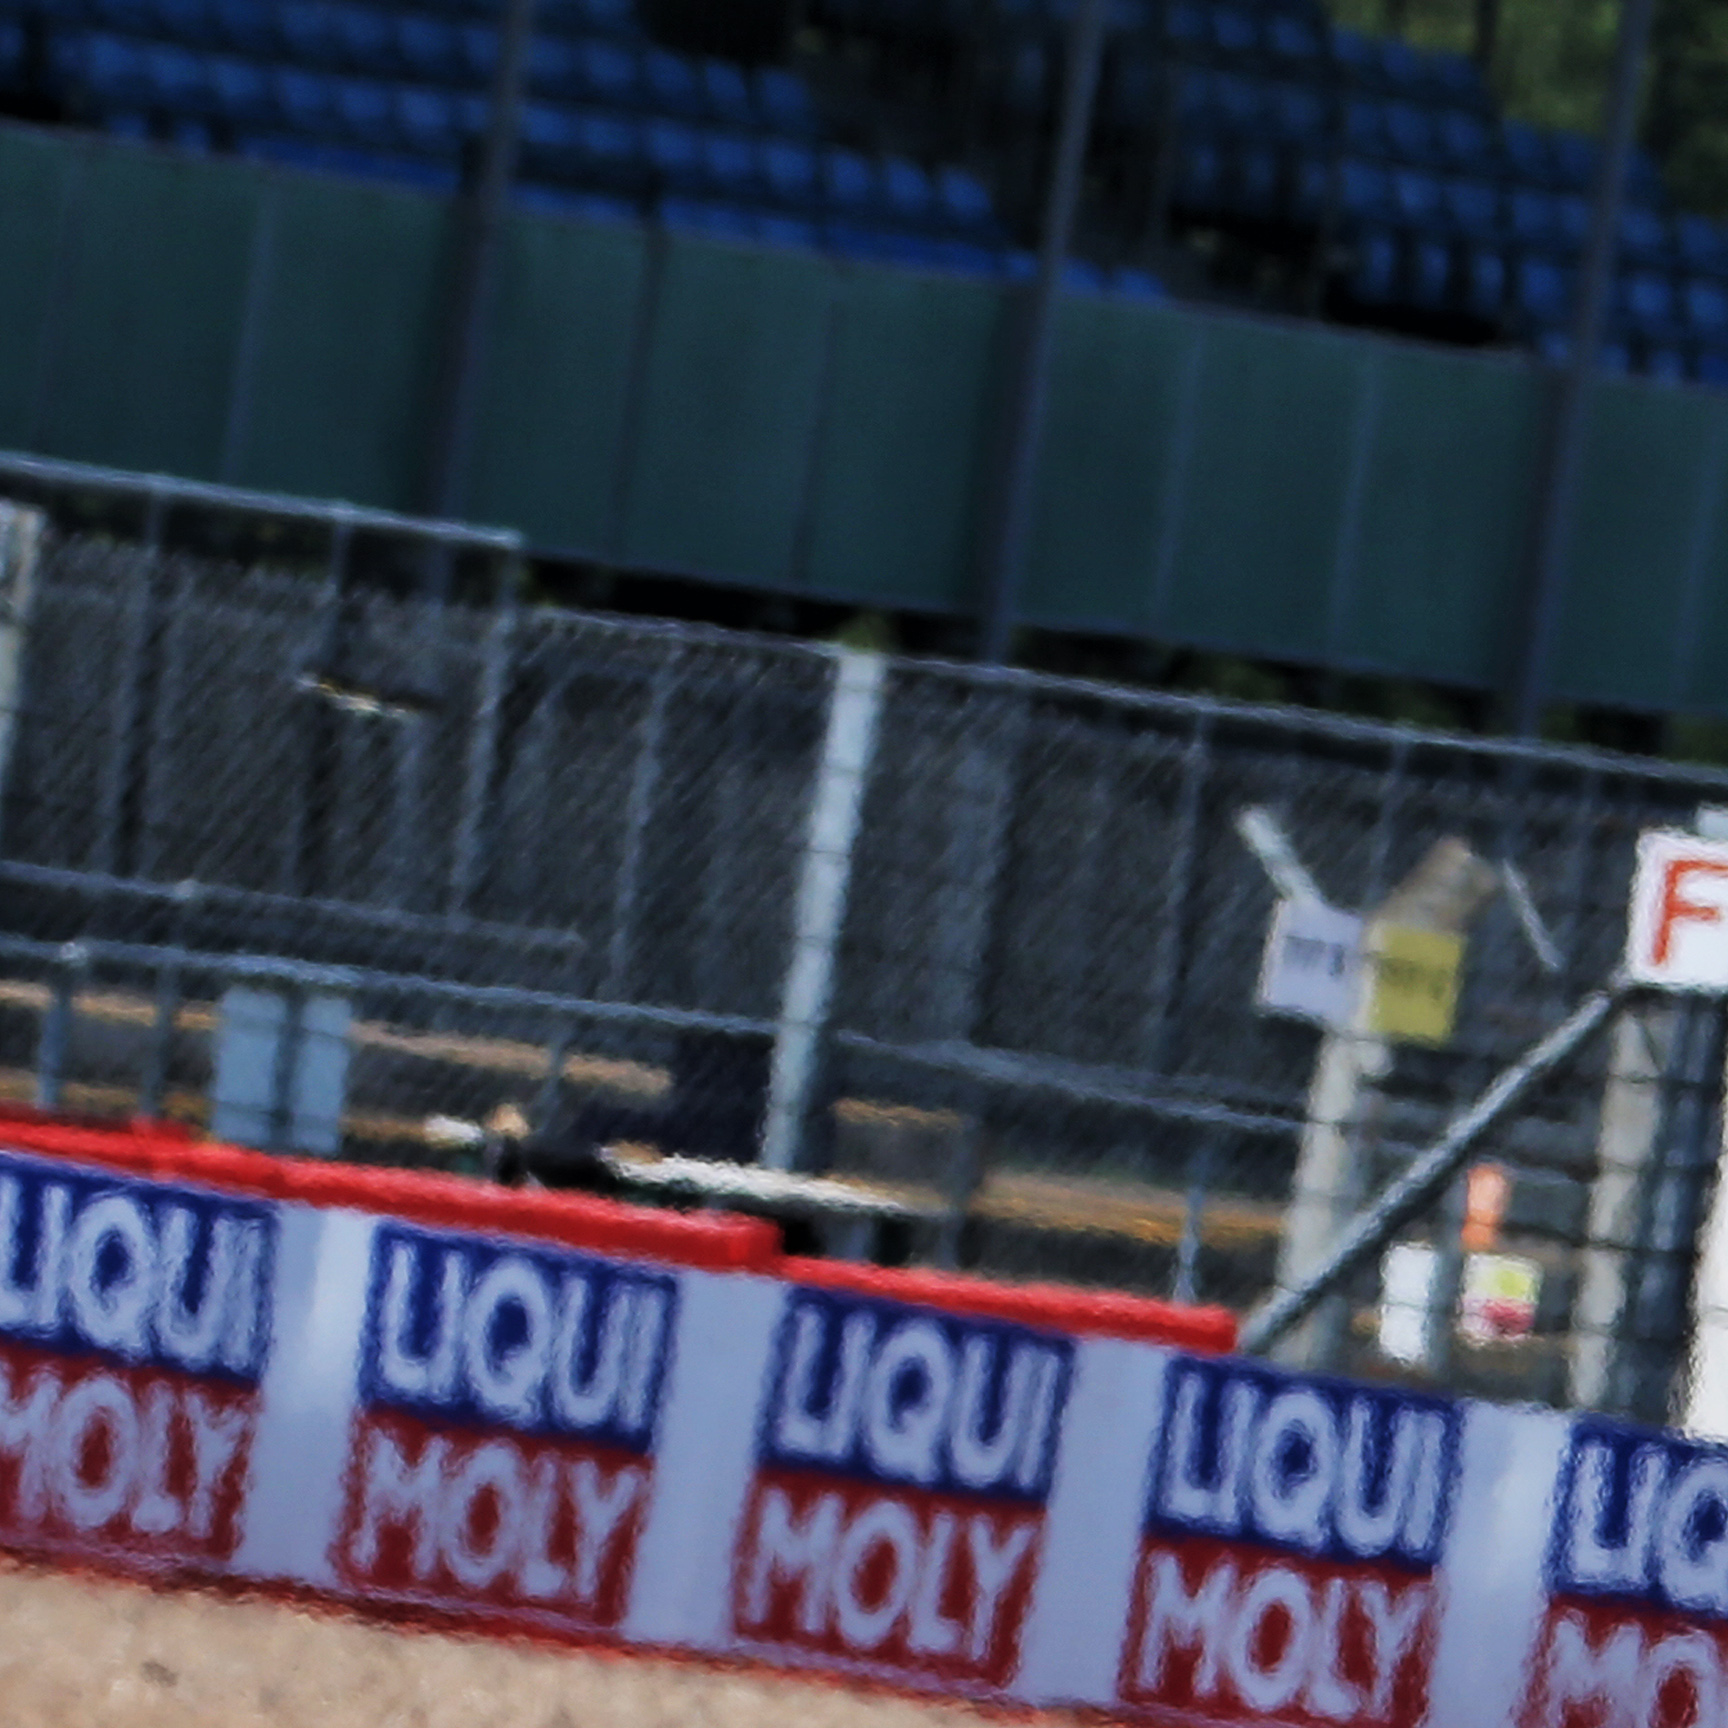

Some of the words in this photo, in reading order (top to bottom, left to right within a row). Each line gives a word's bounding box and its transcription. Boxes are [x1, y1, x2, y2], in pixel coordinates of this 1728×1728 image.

[379, 1238, 667, 1431] LIQUI
[776, 1303, 1060, 1489] LIQUI
[350, 1427, 643, 1612] MOLY
[1158, 1370, 1450, 1556] LIQUI
[745, 1487, 1042, 1665] MOLY
[1139, 1552, 1432, 1725] MOLY
